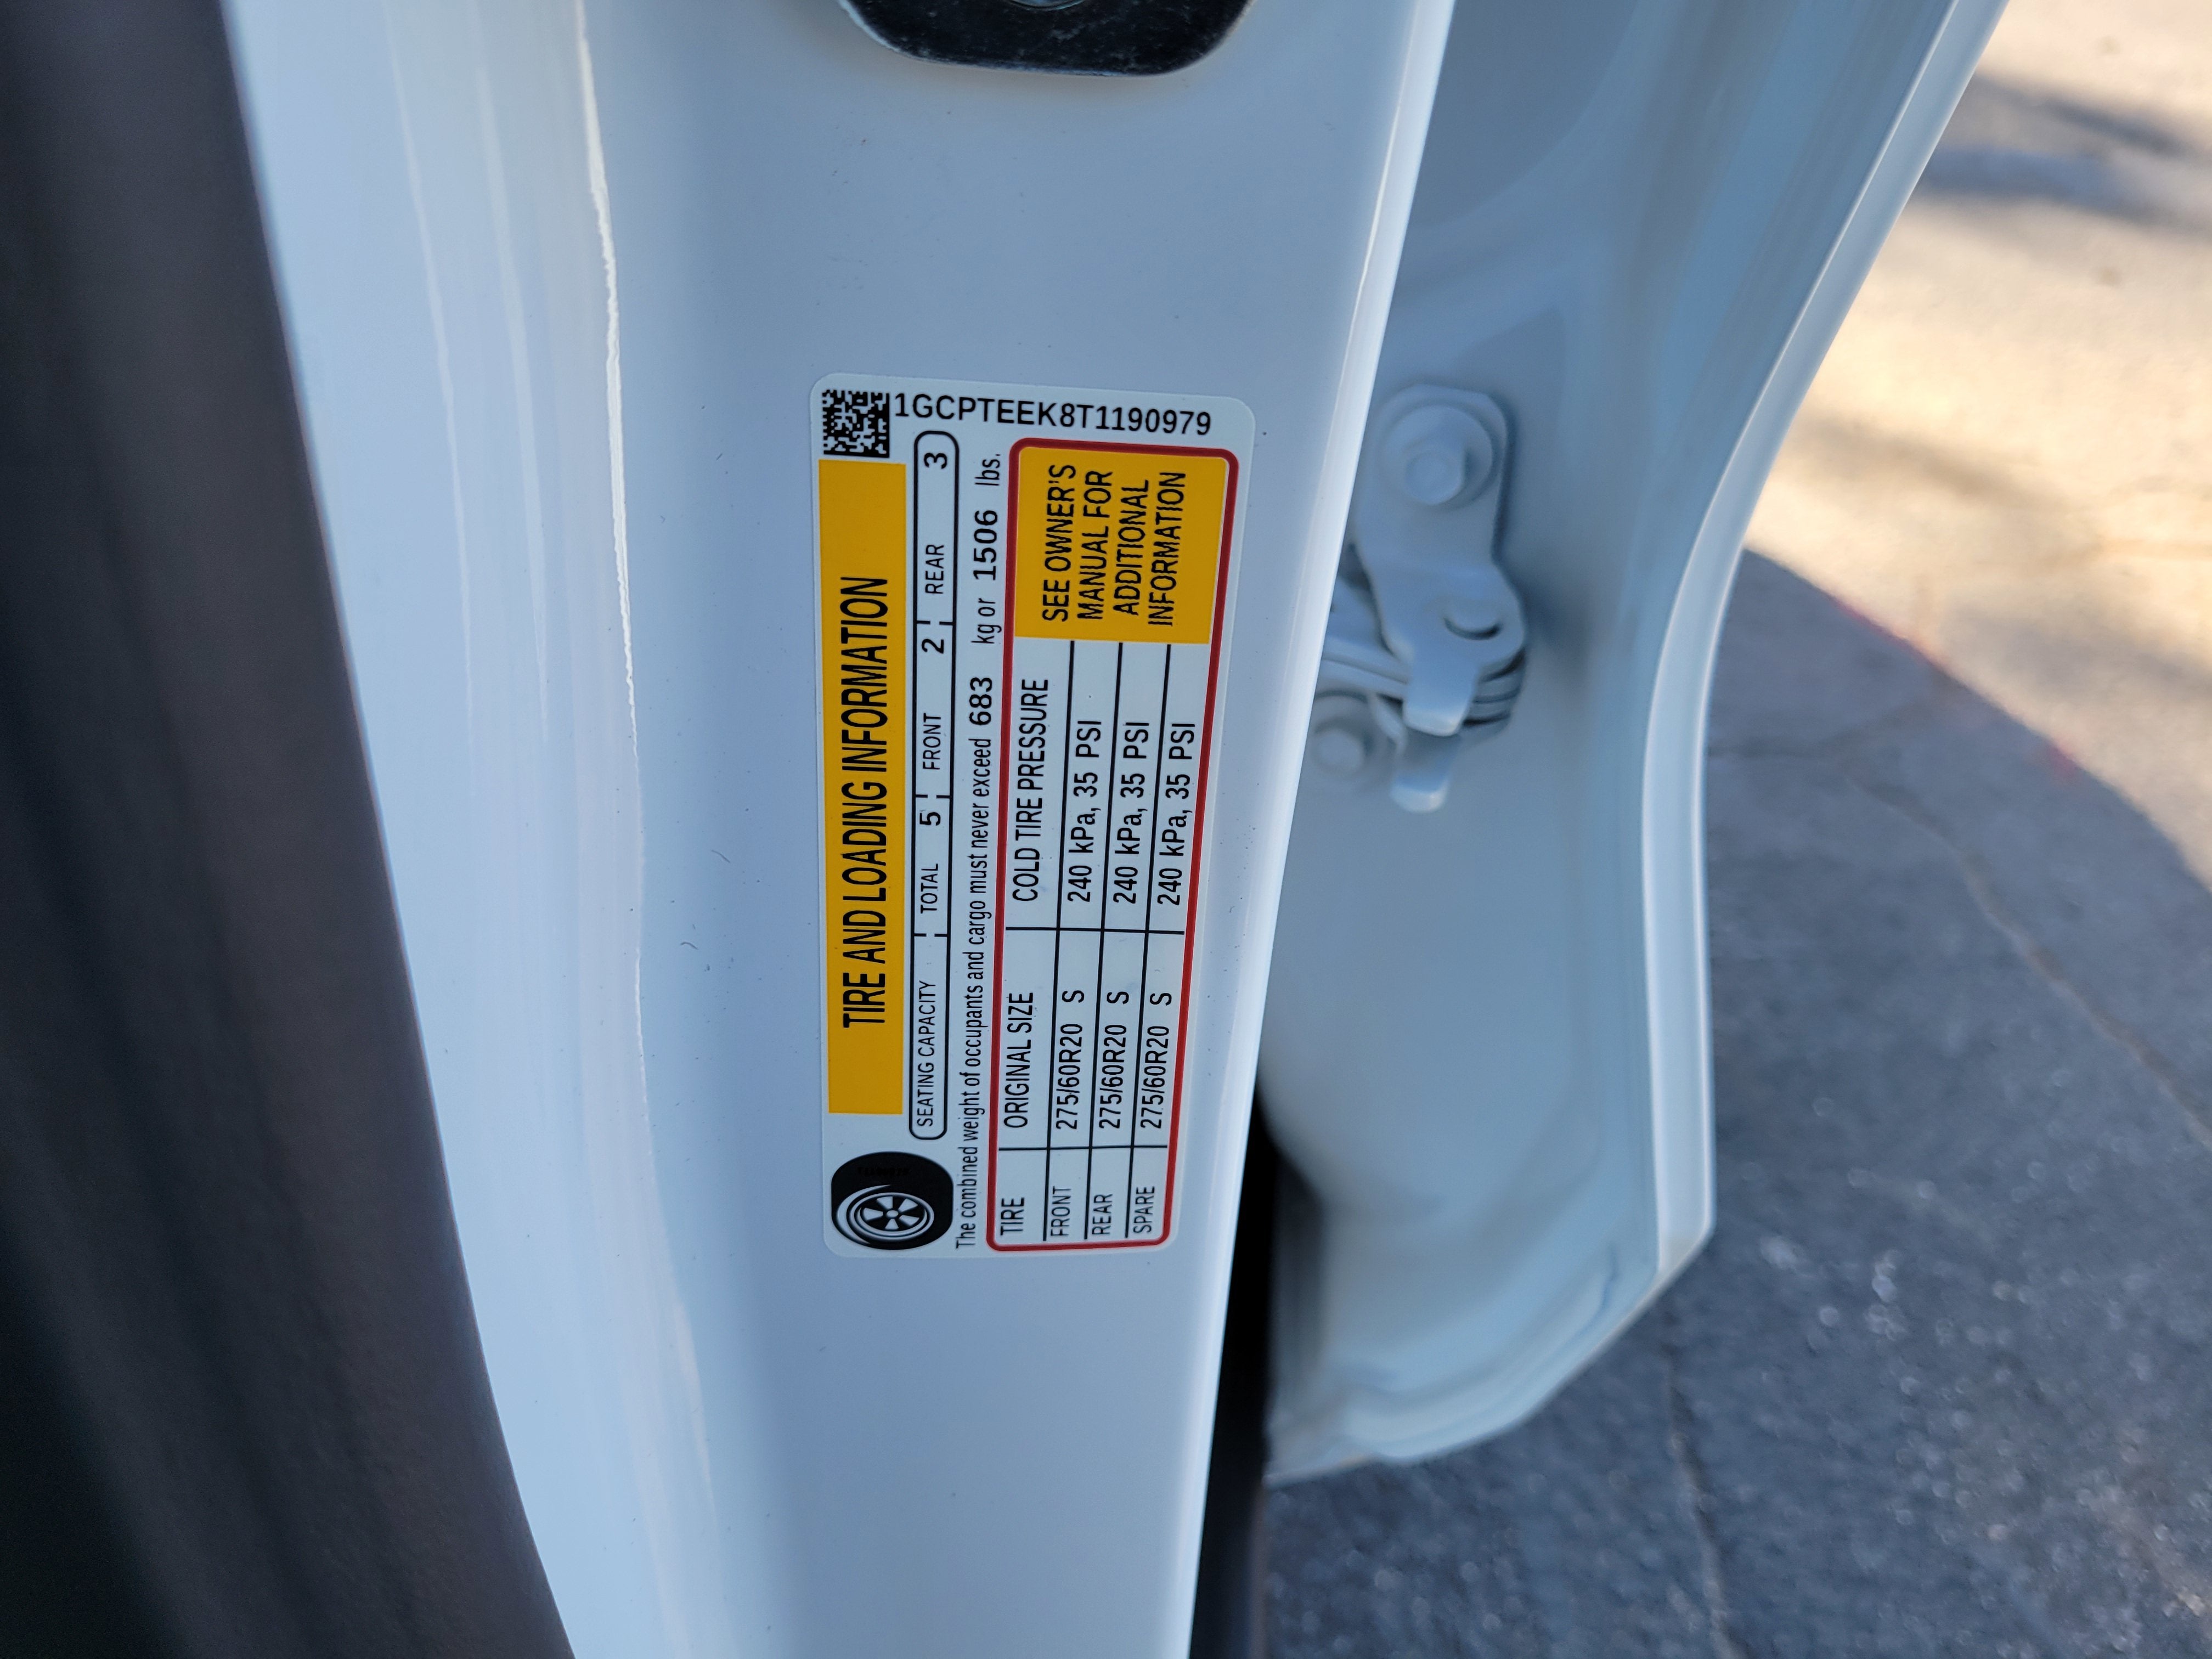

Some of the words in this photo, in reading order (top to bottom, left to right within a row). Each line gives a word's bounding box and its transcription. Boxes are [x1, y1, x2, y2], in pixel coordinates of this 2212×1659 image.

[894, 392, 1212, 436] 1GCPTEEK8T1190979
[923, 452, 948, 470] 3
[974, 454, 1001, 487] lbs.
[1082, 470, 1113, 518] FOR
[1044, 465, 1076, 572] OWNER'S
[973, 510, 998, 581] 1506
[1113, 479, 1149, 616] ADDITIONAL
[1148, 472, 1186, 627] INFORMATION
[924, 544, 945, 595] REAR
[1077, 526, 1109, 620] MANUAL
[978, 597, 996, 617] or
[1042, 579, 1070, 622] SEE
[921, 638, 945, 654] 2
[970, 624, 1002, 644] kg
[839, 577, 888, 772] INFORMATION
[968, 676, 993, 726] 683
[922, 712, 941, 770] FRONT
[1017, 679, 1049, 791] PRESSURE
[1075, 720, 1102, 758] PSI
[1122, 722, 1150, 759] PSI
[1168, 723, 1195, 760] PSI
[968, 738, 992, 797] exceed
[1073, 772, 1098, 798] 35
[1120, 773, 1146, 799] 35
[1165, 774, 1190, 800] 35
[841, 782, 888, 902] LOADING
[919, 811, 941, 827] 5
[971, 803, 989, 848] never
[1015, 797, 1043, 842] TIRE
[1068, 808, 1102, 854] kPa,
[1114, 808, 1148, 855] kPa,
[1159, 810, 1193, 856] kPa,
[920, 863, 939, 915] TOTAL
[967, 854, 988, 894] must
[1012, 848, 1040, 902] COLD
[1067, 865, 1092, 902] 240
[1113, 866, 1138, 904] 240
[1156, 868, 1182, 906] 240
[842, 910, 886, 964] AND
[968, 900, 992, 945] cargo
[962, 951, 984, 980] and
[843, 972, 886, 1028] TIRE
[917, 980, 936, 1057] CAPACITY
[1006, 992, 1034, 1034] SIZE
[1062, 990, 1085, 1003] S
[1106, 991, 1130, 1005] S
[1149, 992, 1172, 1006] S
[963, 985, 989, 1067] occupants
[916, 1062, 935, 1127] SEATING
[958, 1071, 981, 1086] of
[1003, 1039, 1031, 1128] ORIGINAL
[1056, 1024, 1083, 1130] 275/60R20
[1098, 1024, 1127, 1129] 275/60R20
[1140, 1025, 1170, 1129] 275/60R20
[958, 1091, 986, 1142] weight
[956, 1146, 978, 1218] combined
[1000, 1197, 1025, 1237] TIRE
[1049, 1185, 1071, 1237] FRONT
[1091, 1193, 1113, 1235] REAR
[1132, 1186, 1155, 1234] SPARE
[955, 1222, 977, 1250] The
